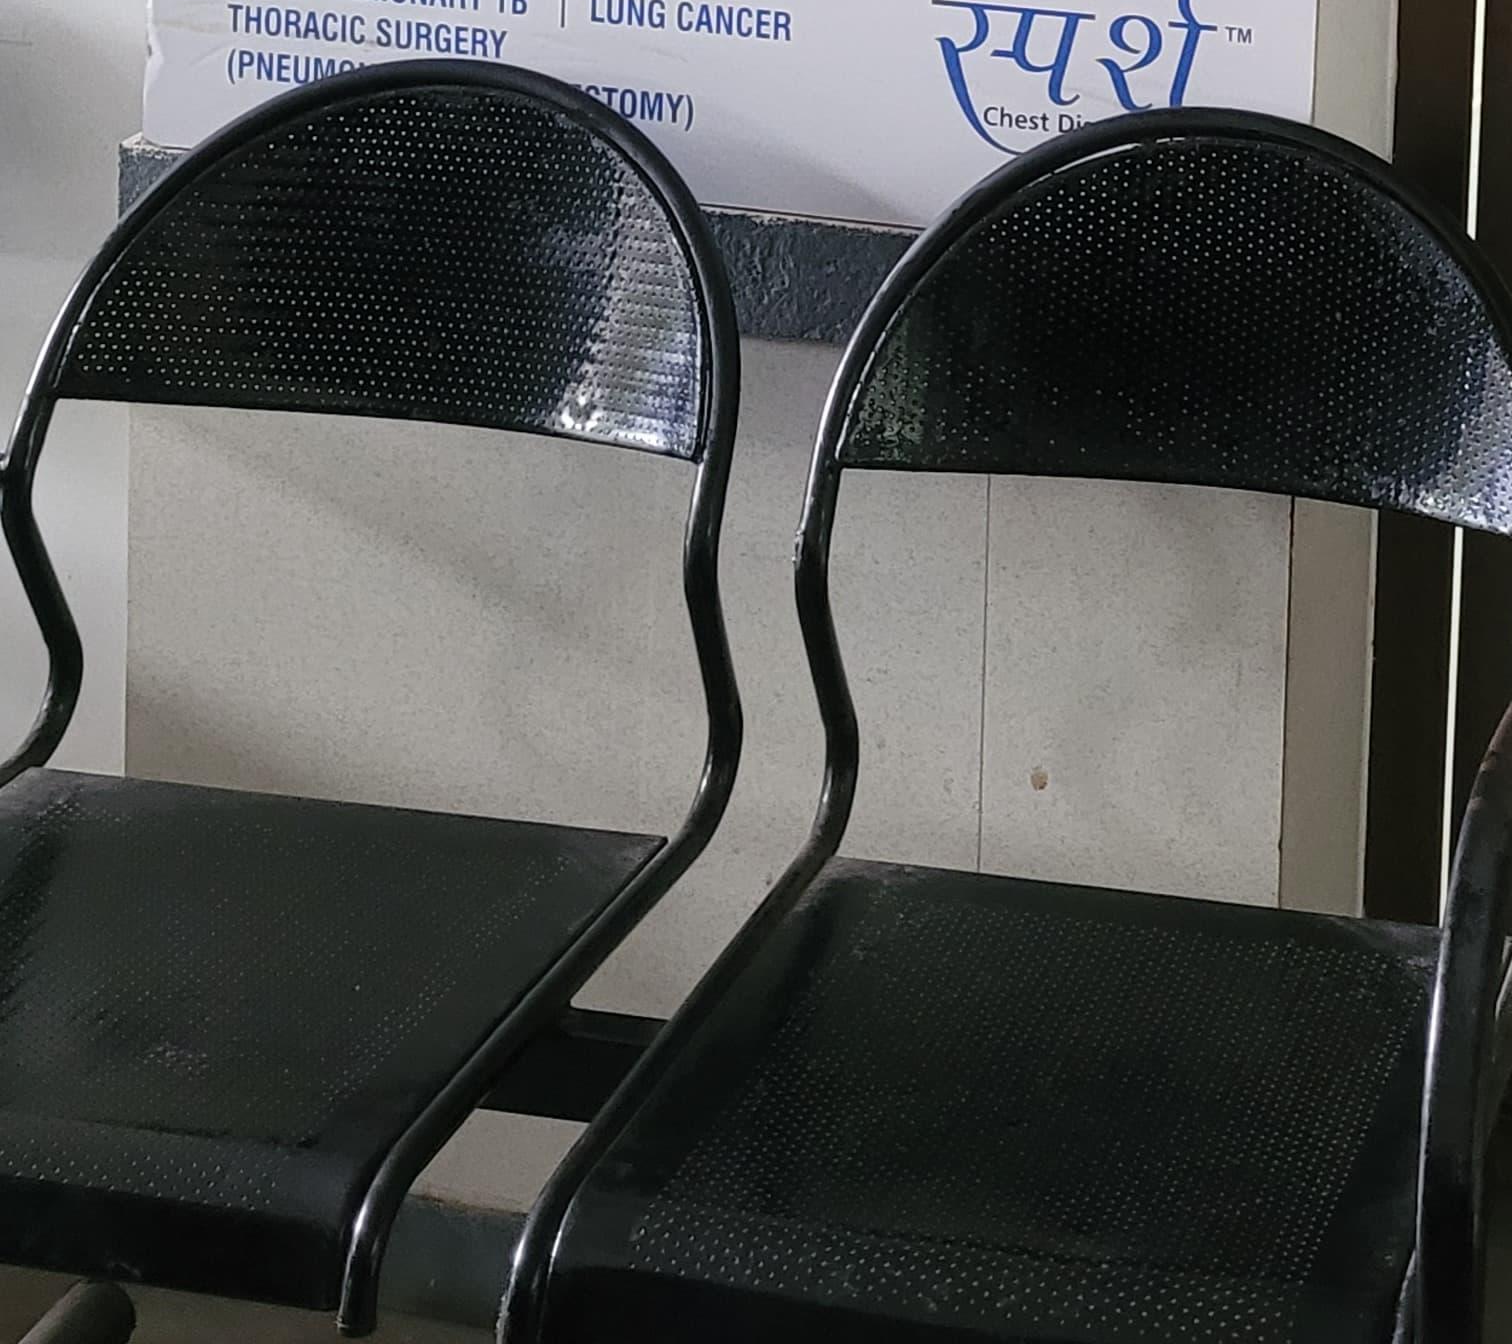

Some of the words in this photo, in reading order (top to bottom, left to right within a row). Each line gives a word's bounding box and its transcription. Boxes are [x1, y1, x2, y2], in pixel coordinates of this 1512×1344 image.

[228, 3, 367, 45] THORACIC
[375, 18, 508, 59] SURGERY
[676, 3, 793, 42] CANCER
[983, 107, 1050, 132] Chest
